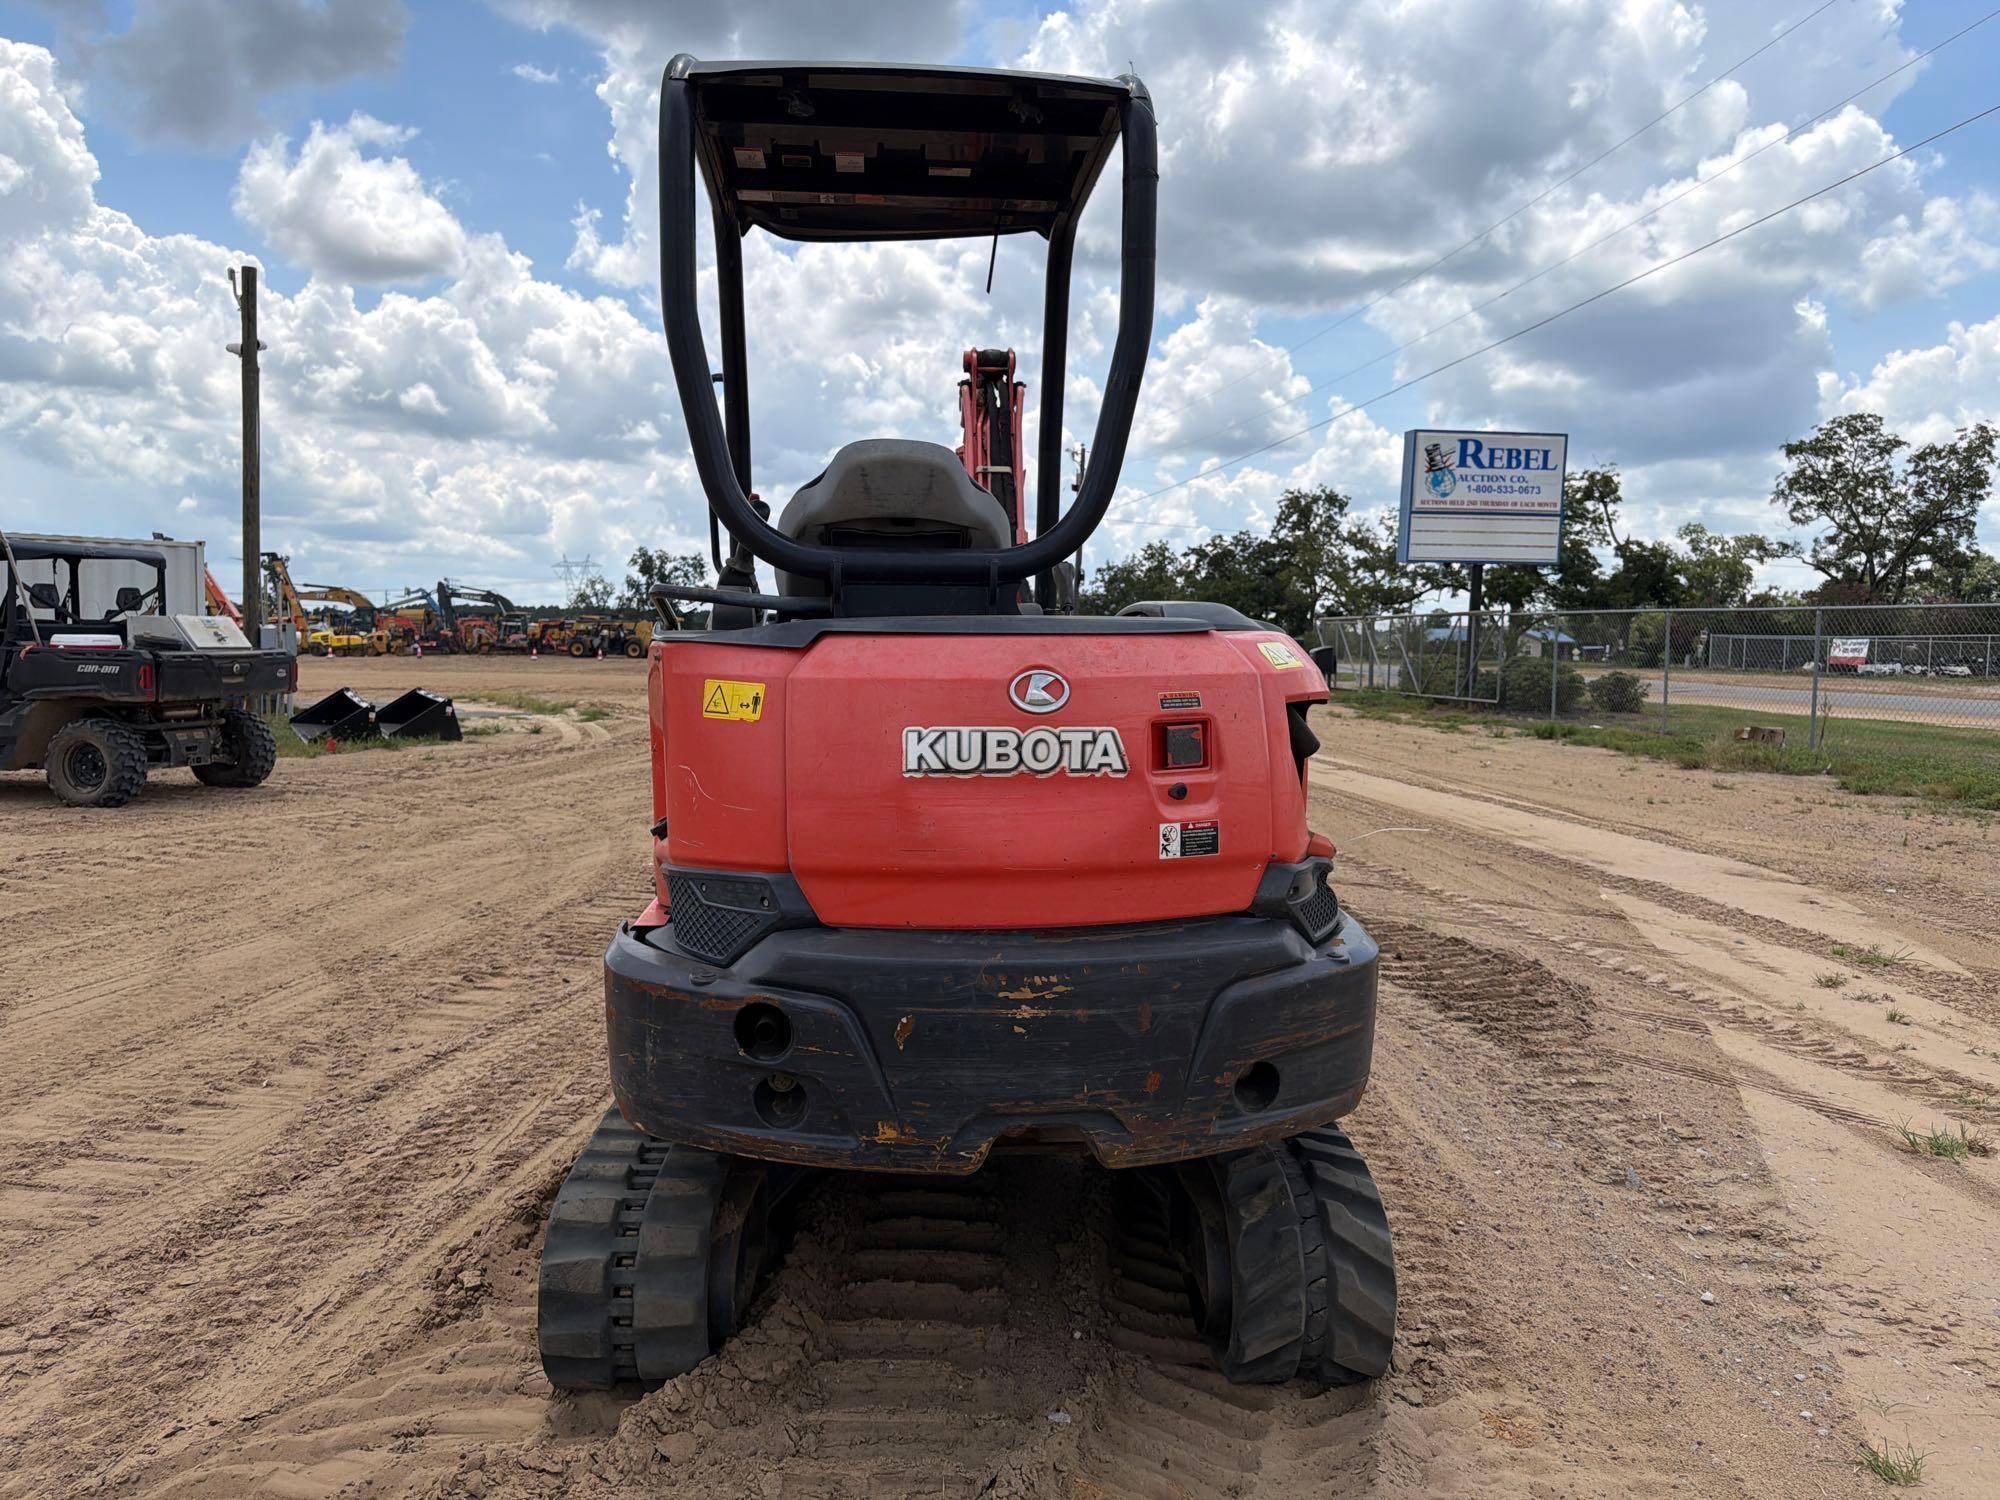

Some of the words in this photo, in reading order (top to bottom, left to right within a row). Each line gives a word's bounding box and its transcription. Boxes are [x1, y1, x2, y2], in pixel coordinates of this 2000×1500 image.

[1456, 438, 1558, 471] REBEL
[1457, 474, 1506, 483] AUCTION
[1509, 475, 1528, 484] CO.
[1467, 485, 1541, 495] 1-800-533-0673
[903, 727, 1129, 777] KUBOTA
